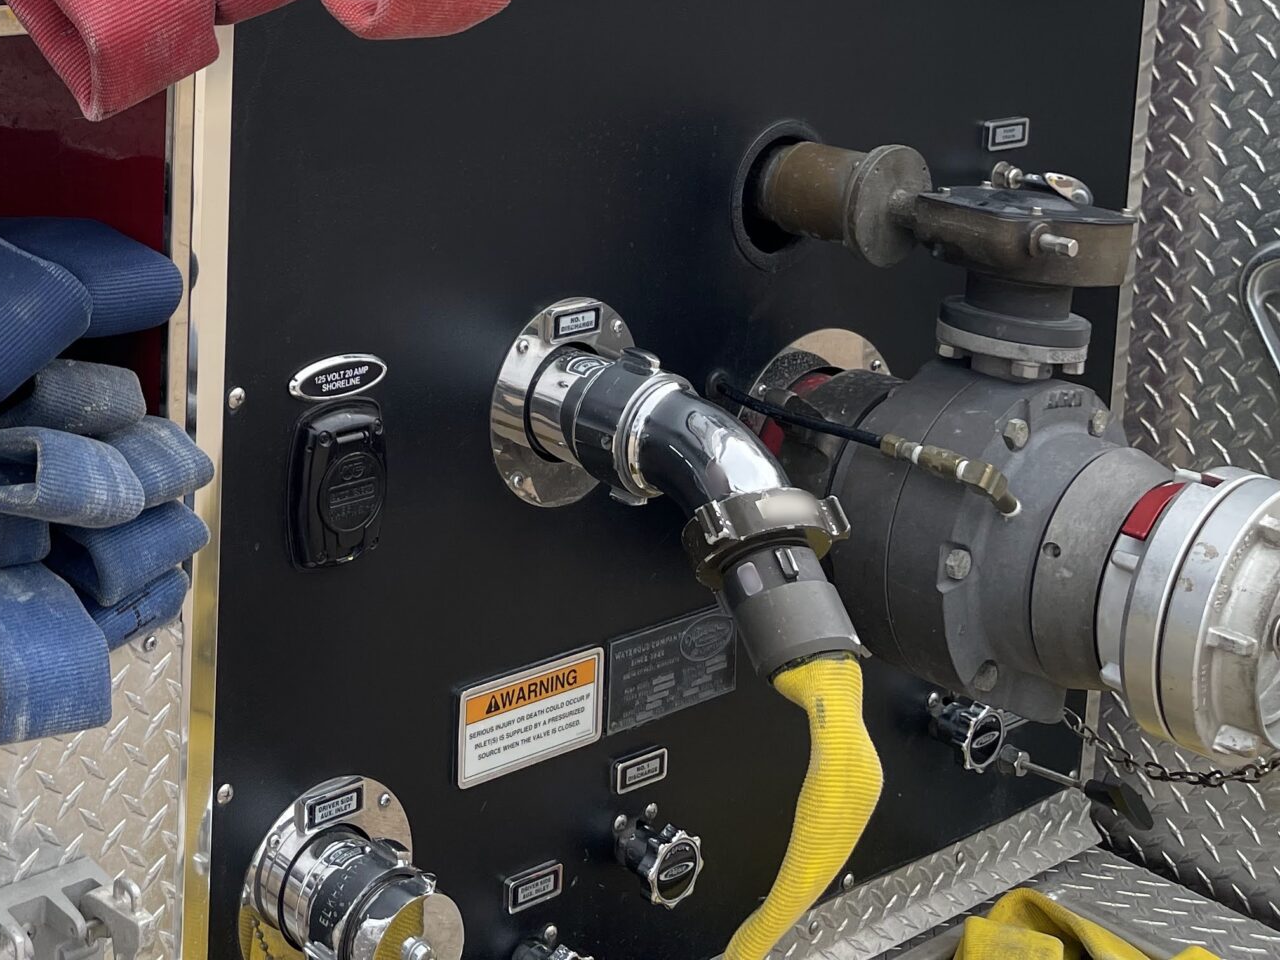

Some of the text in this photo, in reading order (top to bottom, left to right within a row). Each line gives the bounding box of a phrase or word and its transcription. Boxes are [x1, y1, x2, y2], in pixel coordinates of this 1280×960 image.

[314, 365, 369, 384] 125 VOLT 20 AMP
[322, 376, 360, 392] SHORELINE
[499, 669, 578, 709] WARNING
[469, 692, 591, 740] SERIOUS INJURY OR DEATH COULD OCCUR IF
[475, 737, 498, 750] INLET(S)
[499, 734, 505, 742] IS
[505, 724, 532, 739] SUPPLIED
[533, 721, 541, 730] BY
[548, 706, 585, 724] PRESSURIZED
[478, 746, 501, 760] SOURCE
[503, 741, 520, 752] WHEN
[521, 736, 532, 745] THE
[533, 729, 551, 741] VALVE
[551, 727, 557, 735] IS
[319, 795, 353, 813] DRIVER SIDE
[321, 803, 351, 819] AUX. INLET
